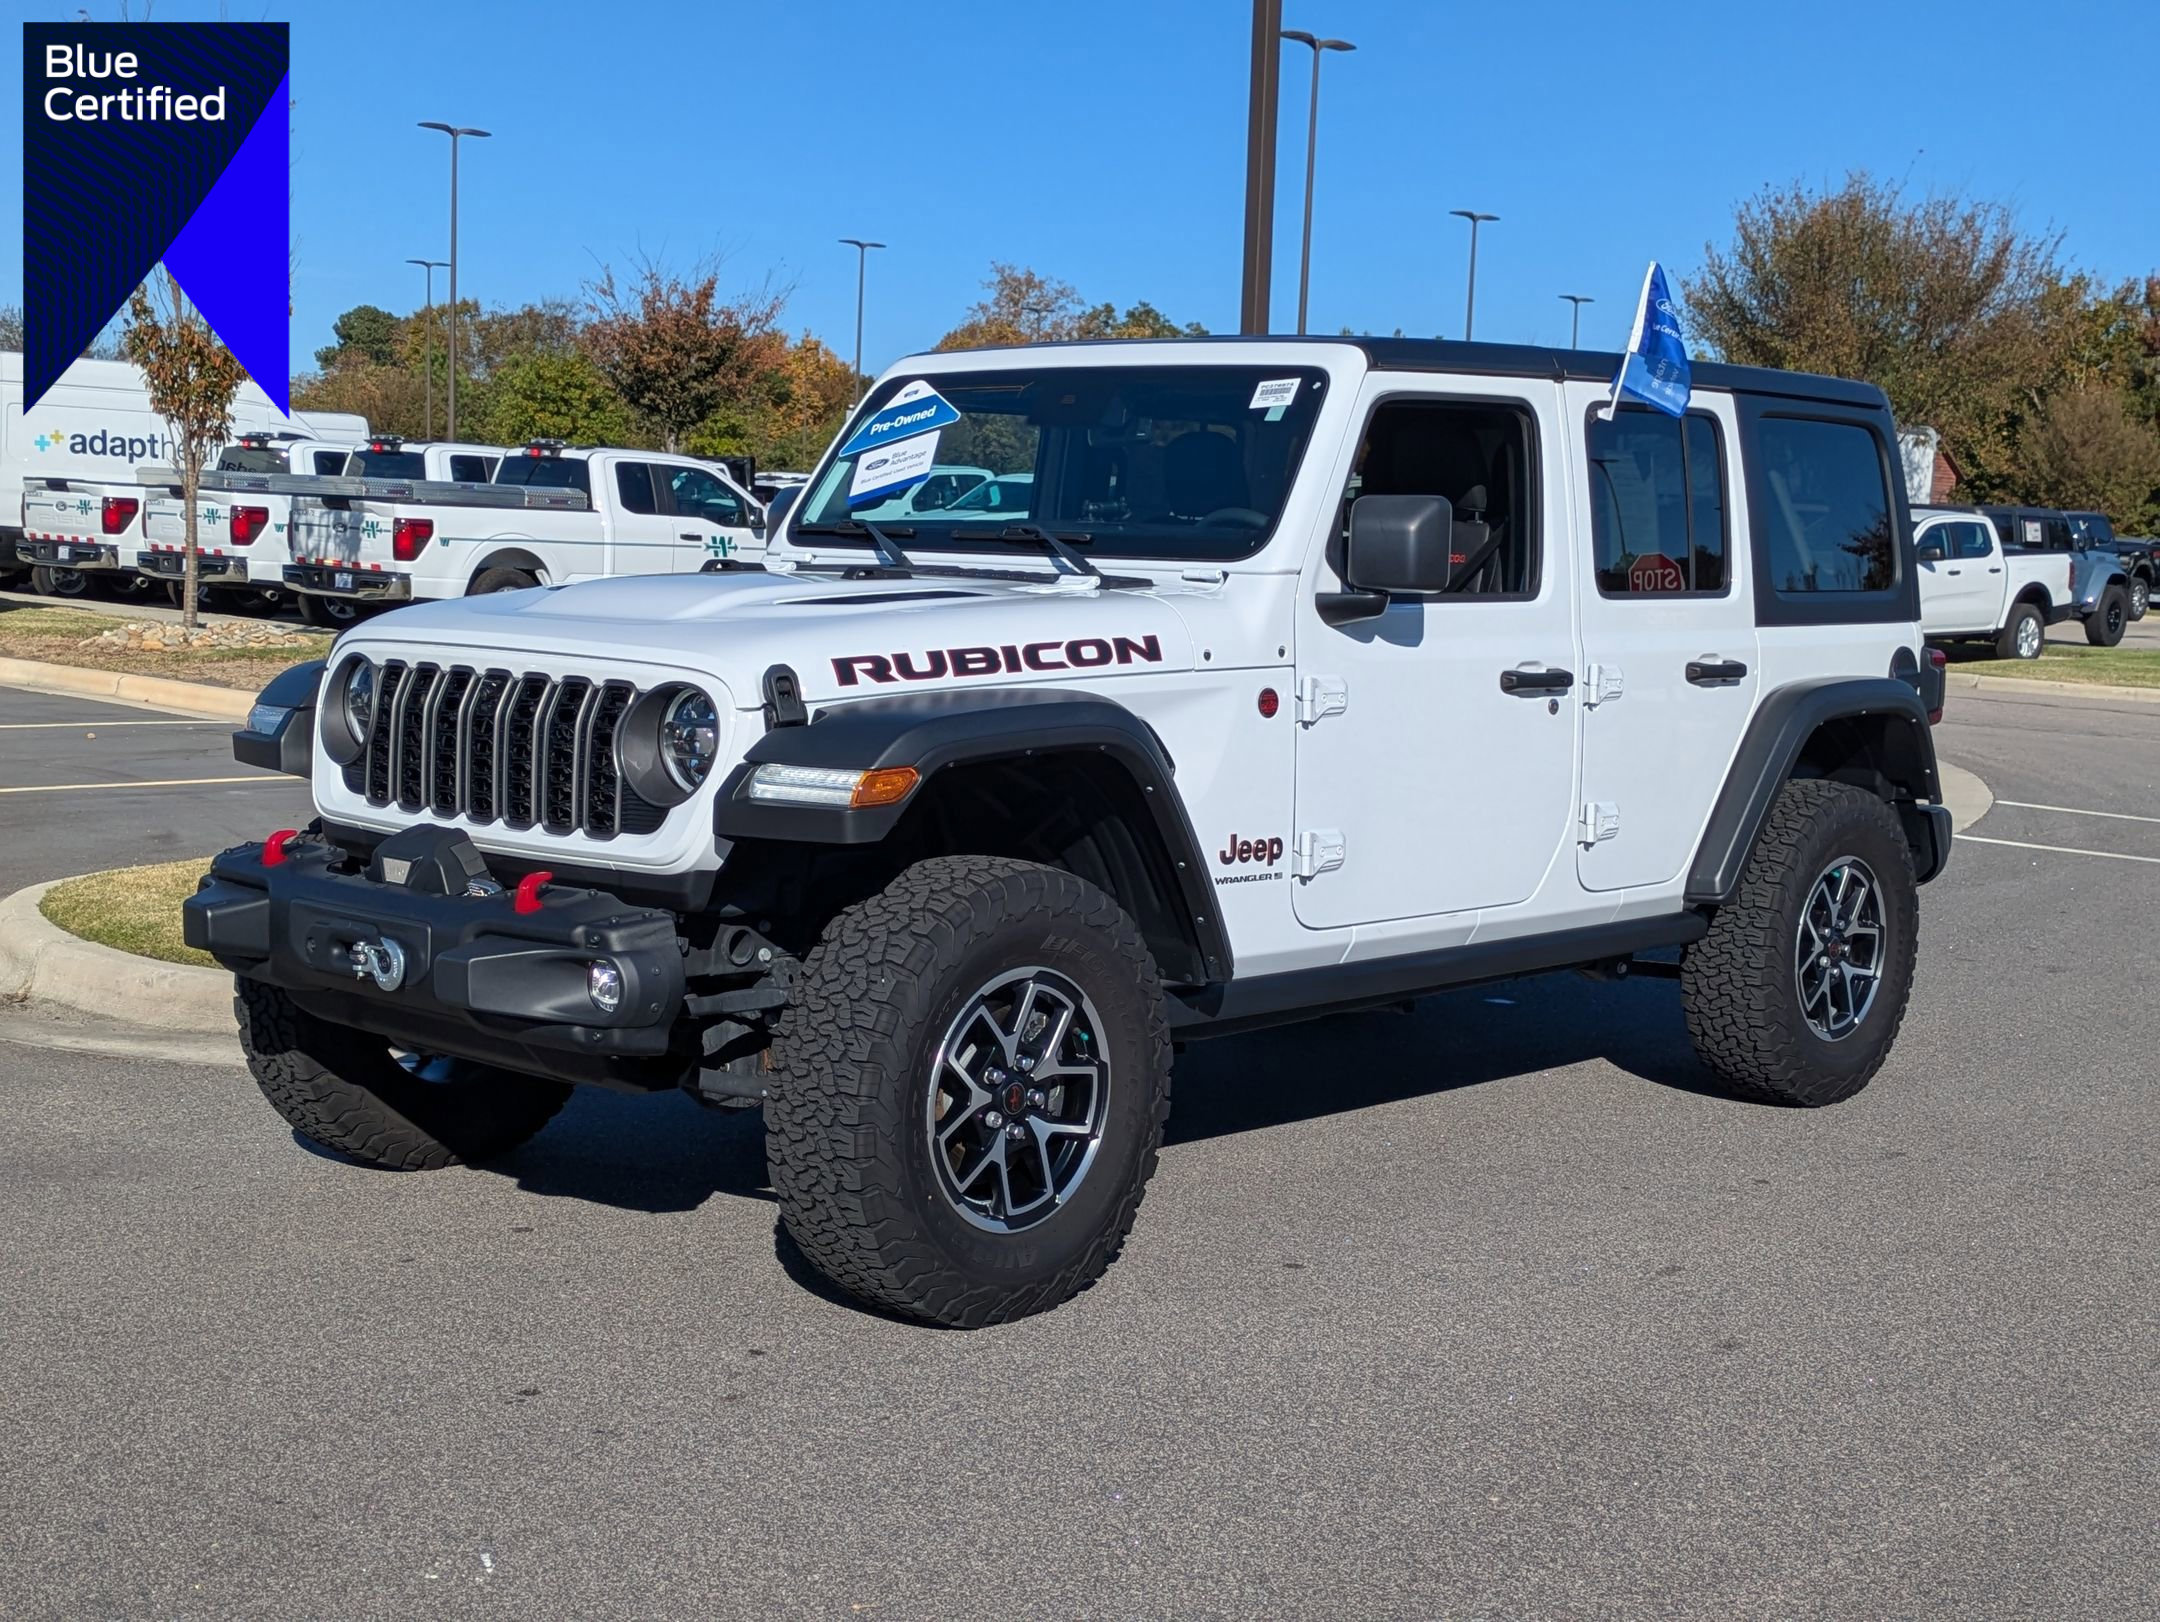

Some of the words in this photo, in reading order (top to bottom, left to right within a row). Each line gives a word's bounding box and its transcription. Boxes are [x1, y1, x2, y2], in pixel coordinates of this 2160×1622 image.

[869, 405, 937, 435] Pre-Owned
[890, 451, 927, 466] Advantage
[892, 450, 908, 459] Blue
[830, 634, 1162, 687] RUBICON
[1219, 833, 1283, 867] Jeep
[1214, 873, 1273, 885] WRANGLER
